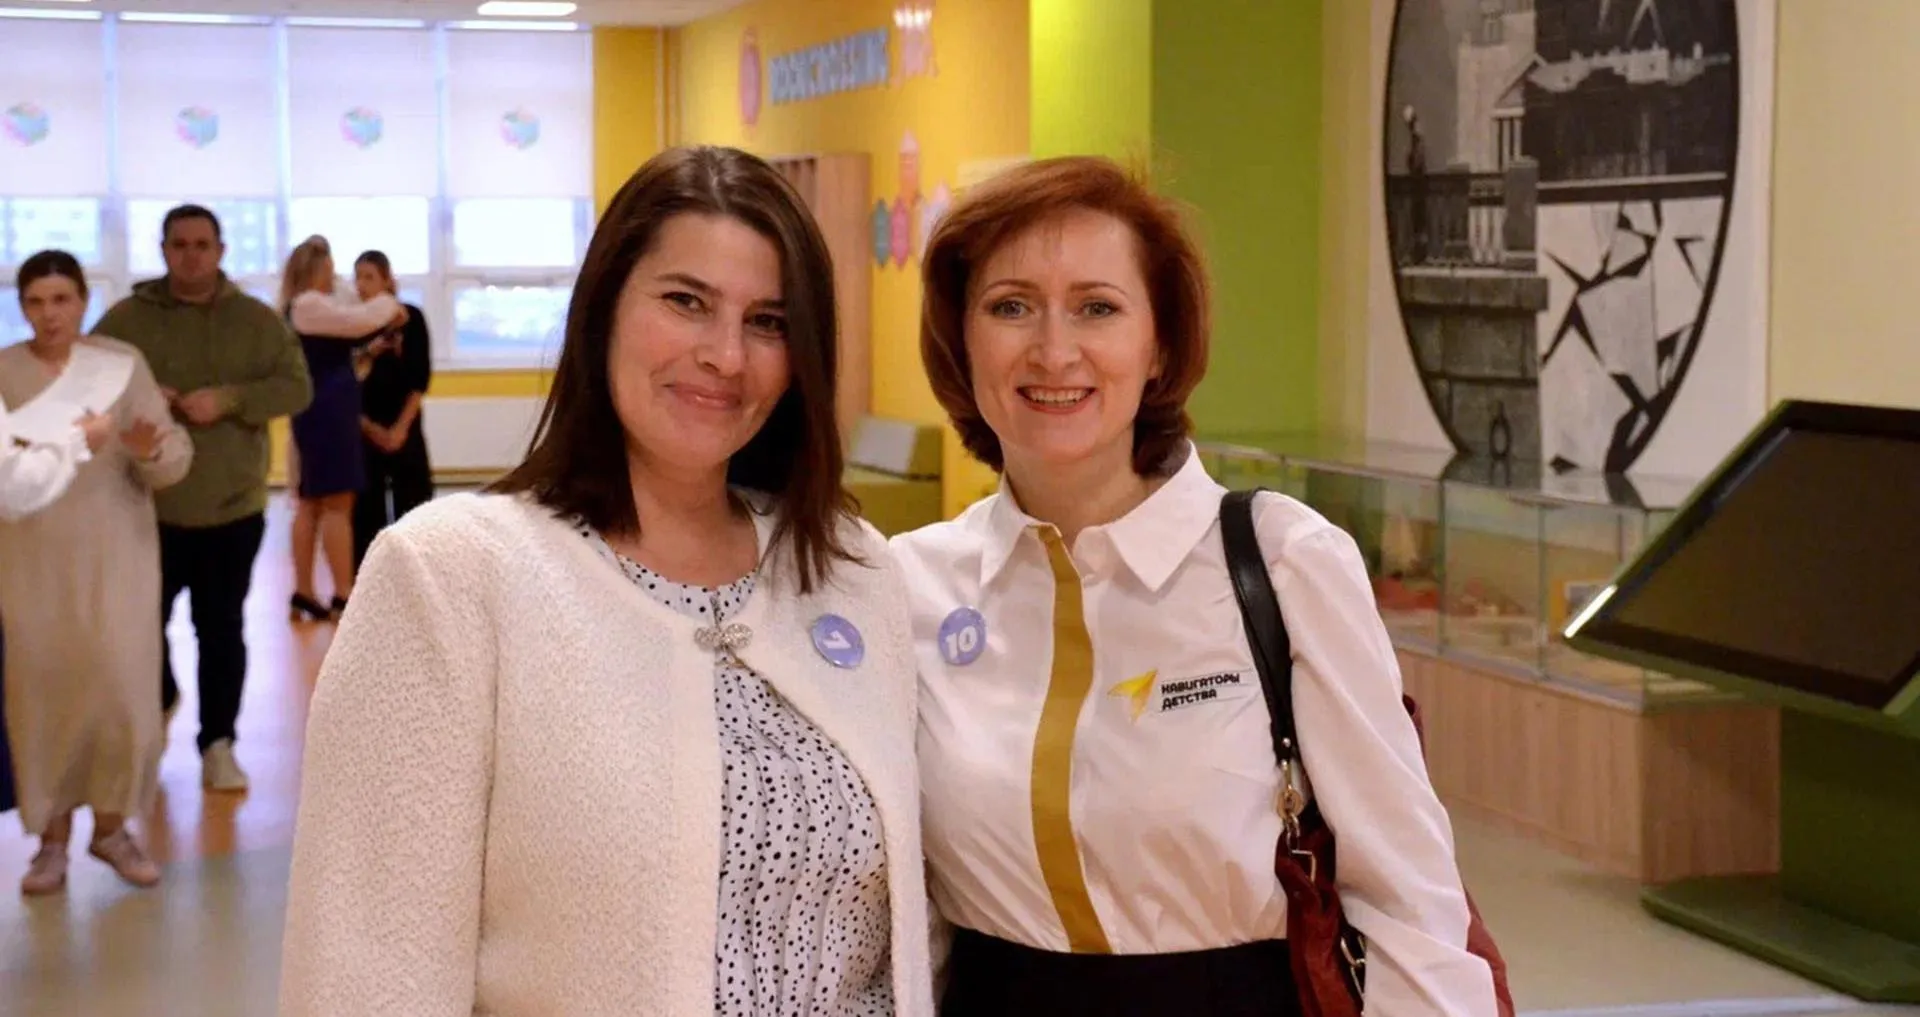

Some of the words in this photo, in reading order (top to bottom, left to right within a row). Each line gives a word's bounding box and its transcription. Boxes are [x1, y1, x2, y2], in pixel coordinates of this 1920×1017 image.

[945, 626, 978, 661] 10
[1161, 673, 1240, 694] НАВИГАТОРЫ
[1162, 689, 1217, 711] ДЕТСТВА
